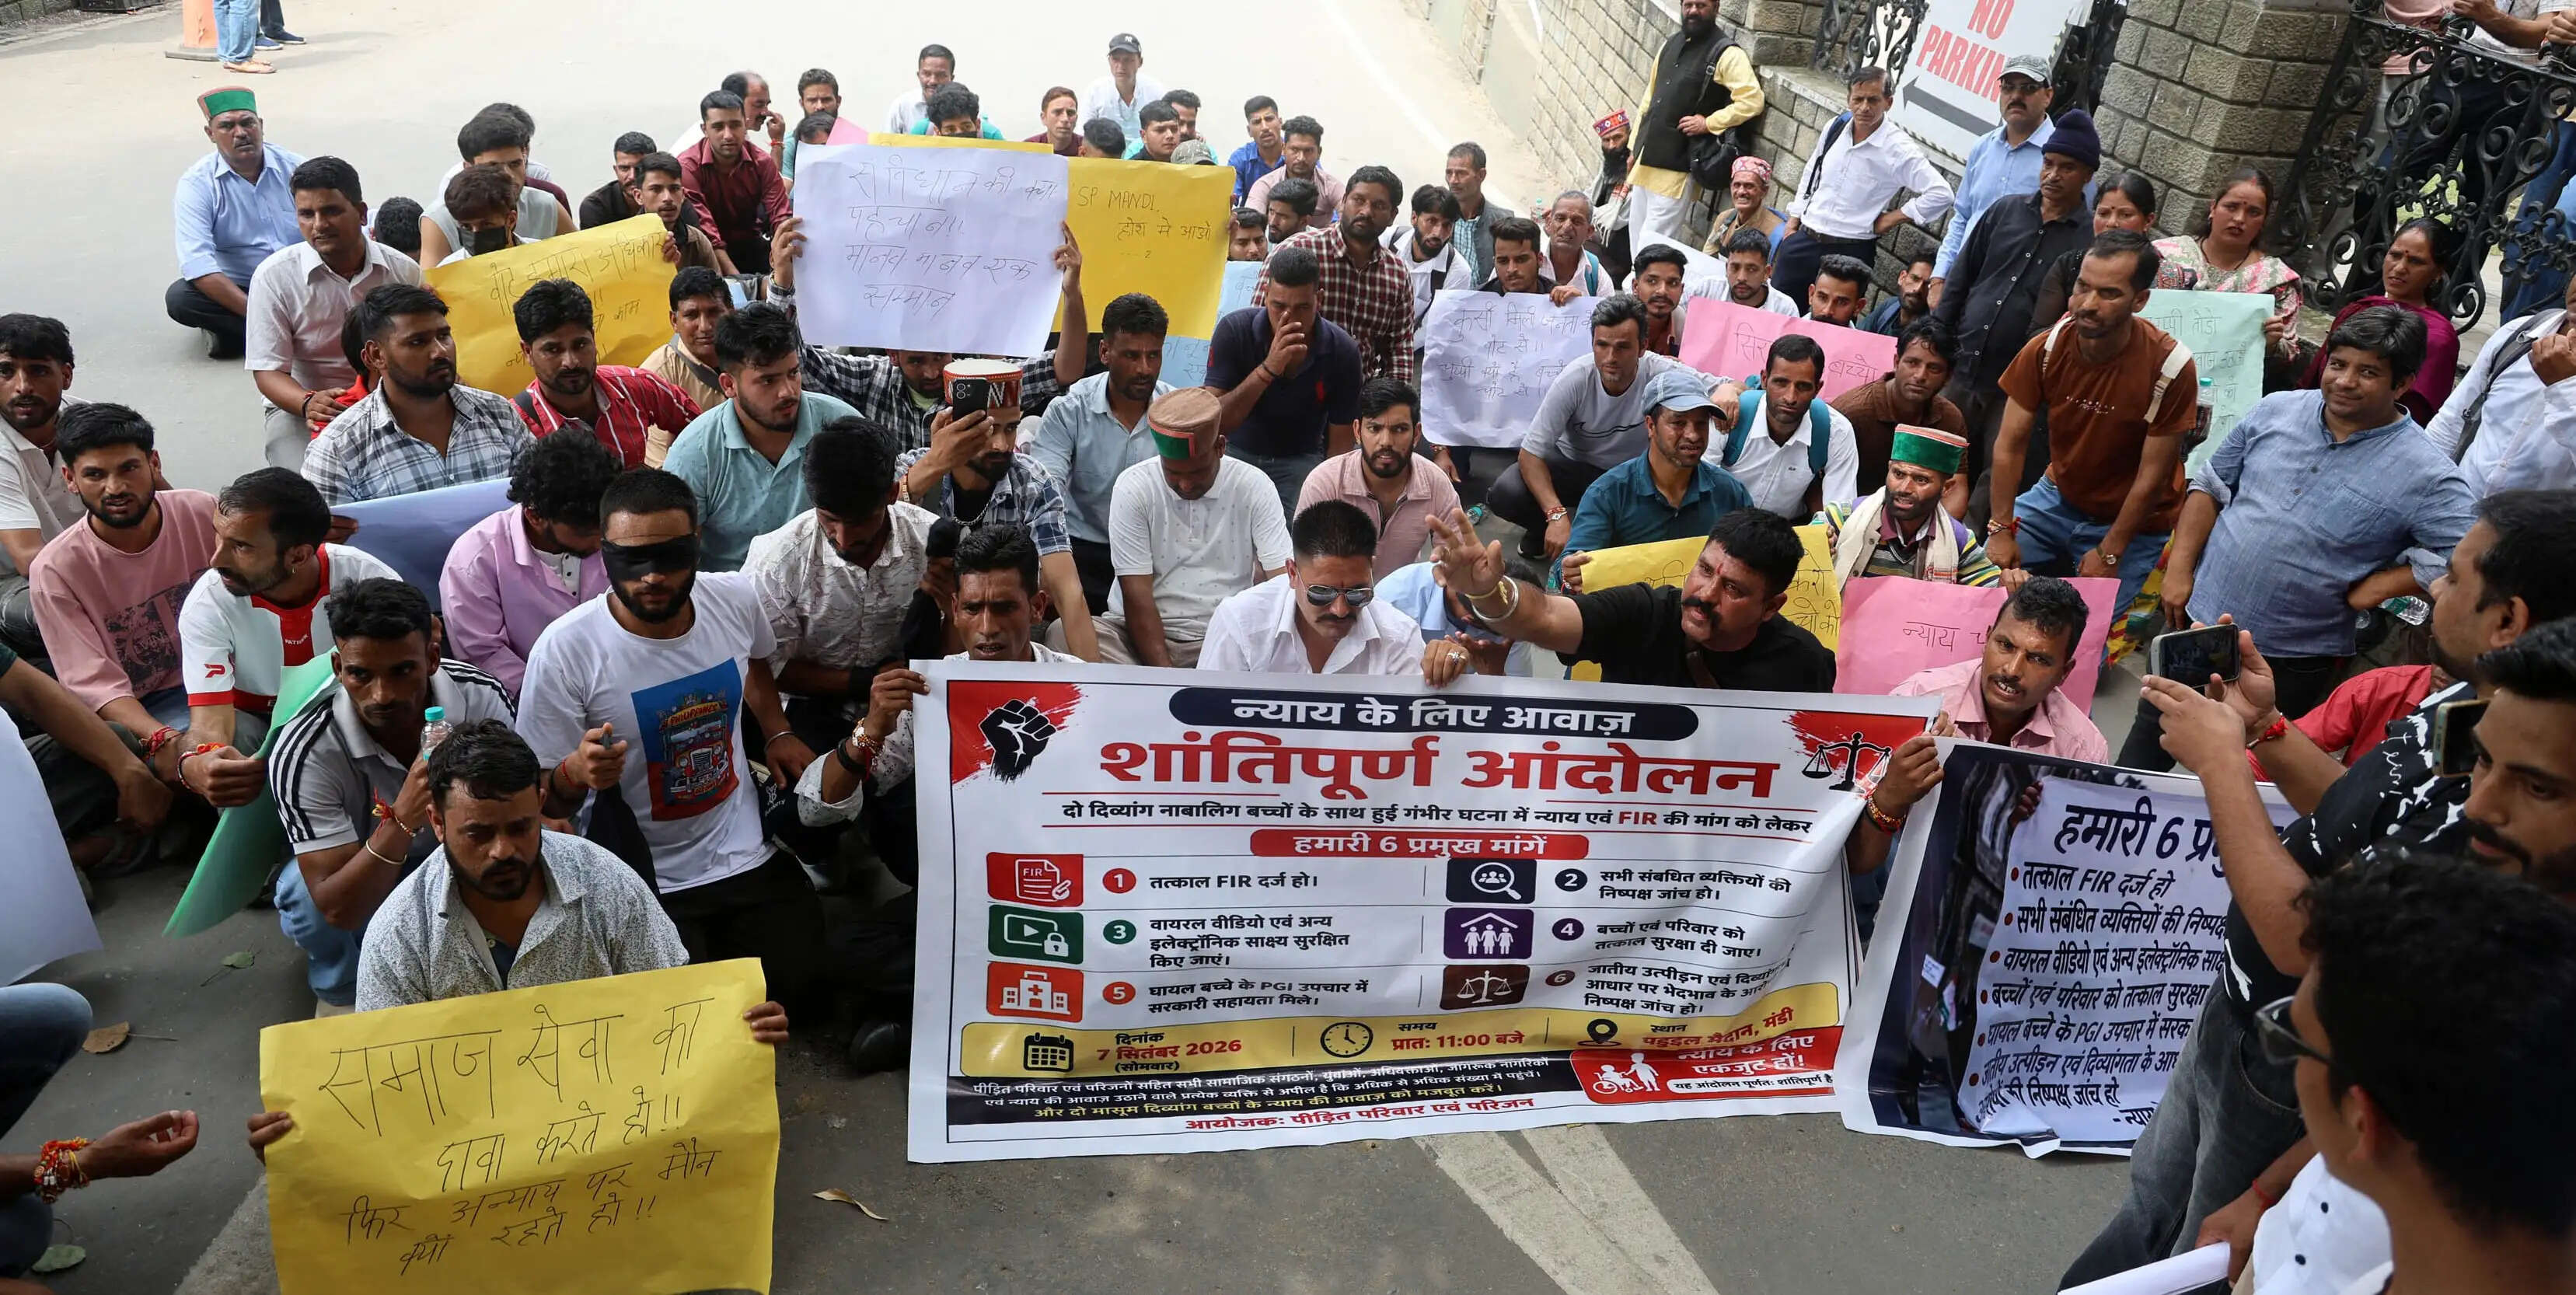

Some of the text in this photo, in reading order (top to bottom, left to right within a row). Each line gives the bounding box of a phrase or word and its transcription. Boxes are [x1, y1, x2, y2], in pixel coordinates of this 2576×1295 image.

[1967, 0, 2015, 40] NO
[1915, 24, 2007, 103] PARKIN
[1077, 187, 1098, 207] SP
[1902, 621, 1960, 652] न्याय
[1230, 696, 1635, 735] न्याय के लिए आवाज़
[1100, 731, 1779, 800] शांतिपूर्ण आंदोलन
[1061, 800, 1813, 832] दो दिव्यांग नाबालिग बच्चों के साथ हुई गंभीर घटना में न्याय एवं FIR की मांग को लेकर
[2054, 796, 2183, 859] हमारी 6
[1293, 831, 1550, 858] हमारी 6 प्रमुख मांगें
[1022, 867, 1043, 877] FIR
[1114, 871, 1317, 888] 1 तत्काल FIR दर्ज हो।
[1565, 873, 1578, 888] 2
[1599, 867, 1633, 883] सभी
[1698, 870, 1764, 888] व्यक्तियों
[1768, 878, 1791, 892] की
[2023, 860, 2176, 900] तत्काल FIR दर्ज हो
[1598, 884, 1719, 900] निष्पक्ष जांच हो।
[1113, 913, 1332, 940] 3 वायरल वीडियो एवं अन्य
[2017, 897, 2184, 935] सभी संबंधित व्यक्तियों की
[1149, 931, 1349, 951] इलेक्ट्रॉनिक साक्ष्य सुरक्षित
[1560, 919, 1745, 941] 4 बच्चों एवं परिवार को
[1594, 936, 1761, 958] तत्काल सुरक्षा दी जाए।
[2003, 948, 2053, 973] वायरल
[2052, 938, 2092, 975] वीडियो
[2093, 941, 2110, 976] एवं
[2110, 945, 2137, 972] अन्य
[1588, 962, 1637, 976] जातीय
[1112, 978, 1368, 1000] 5 घायल बच्चे के PGI उपचार में
[1991, 979, 2209, 1011] बच्चों परिवार को तत्काल सुरक्षा
[1147, 993, 1318, 1013] सरकारी सहायता मिले।
[1398, 1022, 1437, 1031] समय
[1650, 1024, 1688, 1032] स्थान
[1763, 1007, 1794, 1028] मंडी
[2022, 1010, 2160, 1043] बच्चे PGI उपचार में
[1097, 1039, 1241, 1060] 7 सितंबर 2026
[1114, 1031, 1164, 1045] दिनांक
[1391, 1030, 1524, 1050] प्रातः 11:00 बजे
[1771, 1035, 1815, 1052] लिए
[318, 997, 715, 1137] समाज सेवा का
[1115, 1060, 1179, 1073] (सोमवार)
[1691, 1059, 1767, 1075] एकजुट
[1695, 1079, 1740, 1089] आंदोलन
[1091, 1105, 1138, 1116] मासूम
[1143, 1102, 1196, 1112] दिव्यांग
[1202, 1100, 1239, 1110] बच्चों
[1416, 1086, 1466, 1097] मजबूत
[1186, 1098, 1534, 1129] आयोजक: पीड़ित परिवार एवं परिजन
[437, 1133, 506, 1193] दावा
[536, 1100, 606, 1166] करते
[338, 1194, 417, 1245] फिर
[452, 1179, 566, 1228] अन्याय
[585, 1161, 634, 1191] पर
[490, 1206, 569, 1245] रहते
